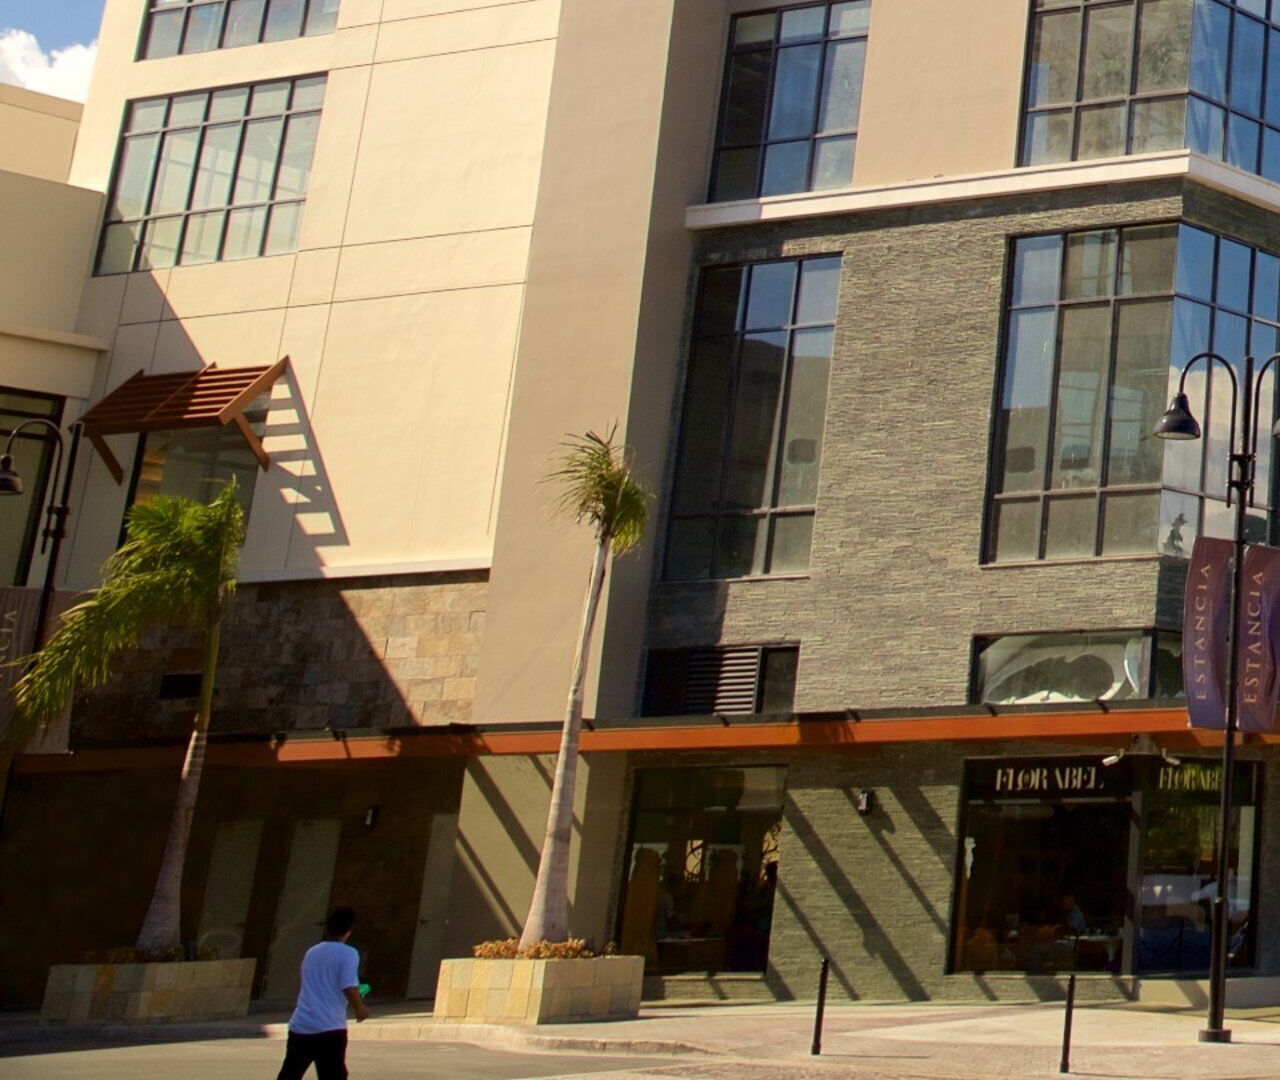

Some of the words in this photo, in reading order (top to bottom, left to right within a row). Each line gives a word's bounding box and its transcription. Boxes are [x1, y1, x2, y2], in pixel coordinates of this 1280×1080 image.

[1194, 564, 1212, 700] ESTANCIA
[1244, 572, 1264, 703] ESTANCIA
[995, 767, 1048, 791] FLOR
[1053, 766, 1104, 790] ABEL
